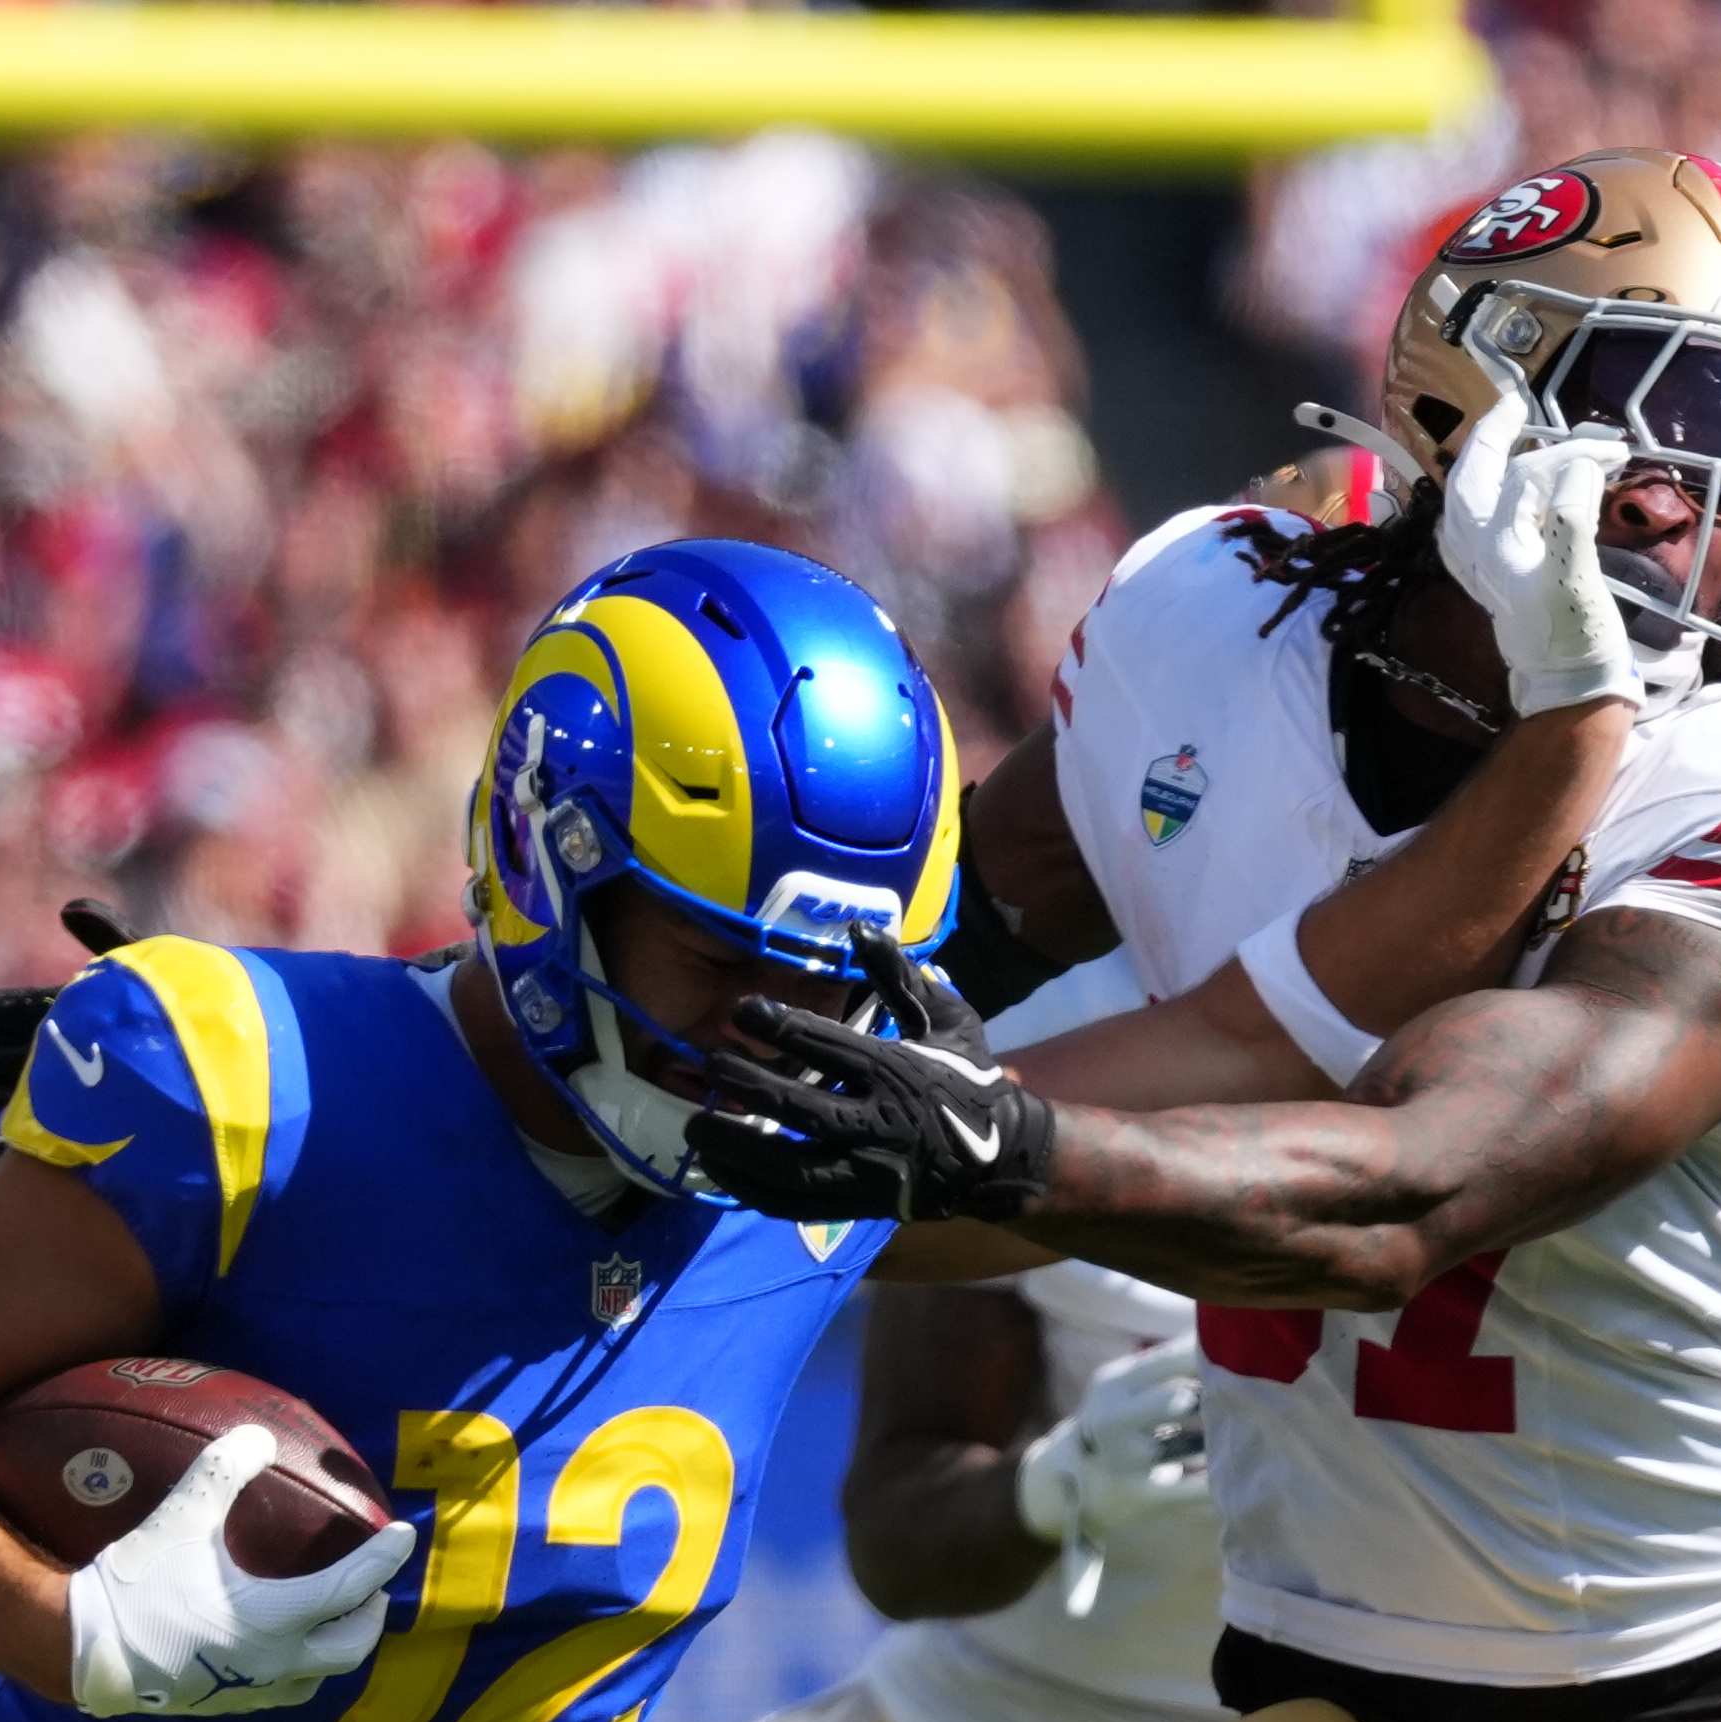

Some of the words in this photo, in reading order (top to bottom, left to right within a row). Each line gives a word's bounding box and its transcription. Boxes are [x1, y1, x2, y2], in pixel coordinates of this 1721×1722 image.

[790, 891, 895, 930] RAMS
[601, 1287, 633, 1315] NFL
[123, 1358, 196, 1380] NFL
